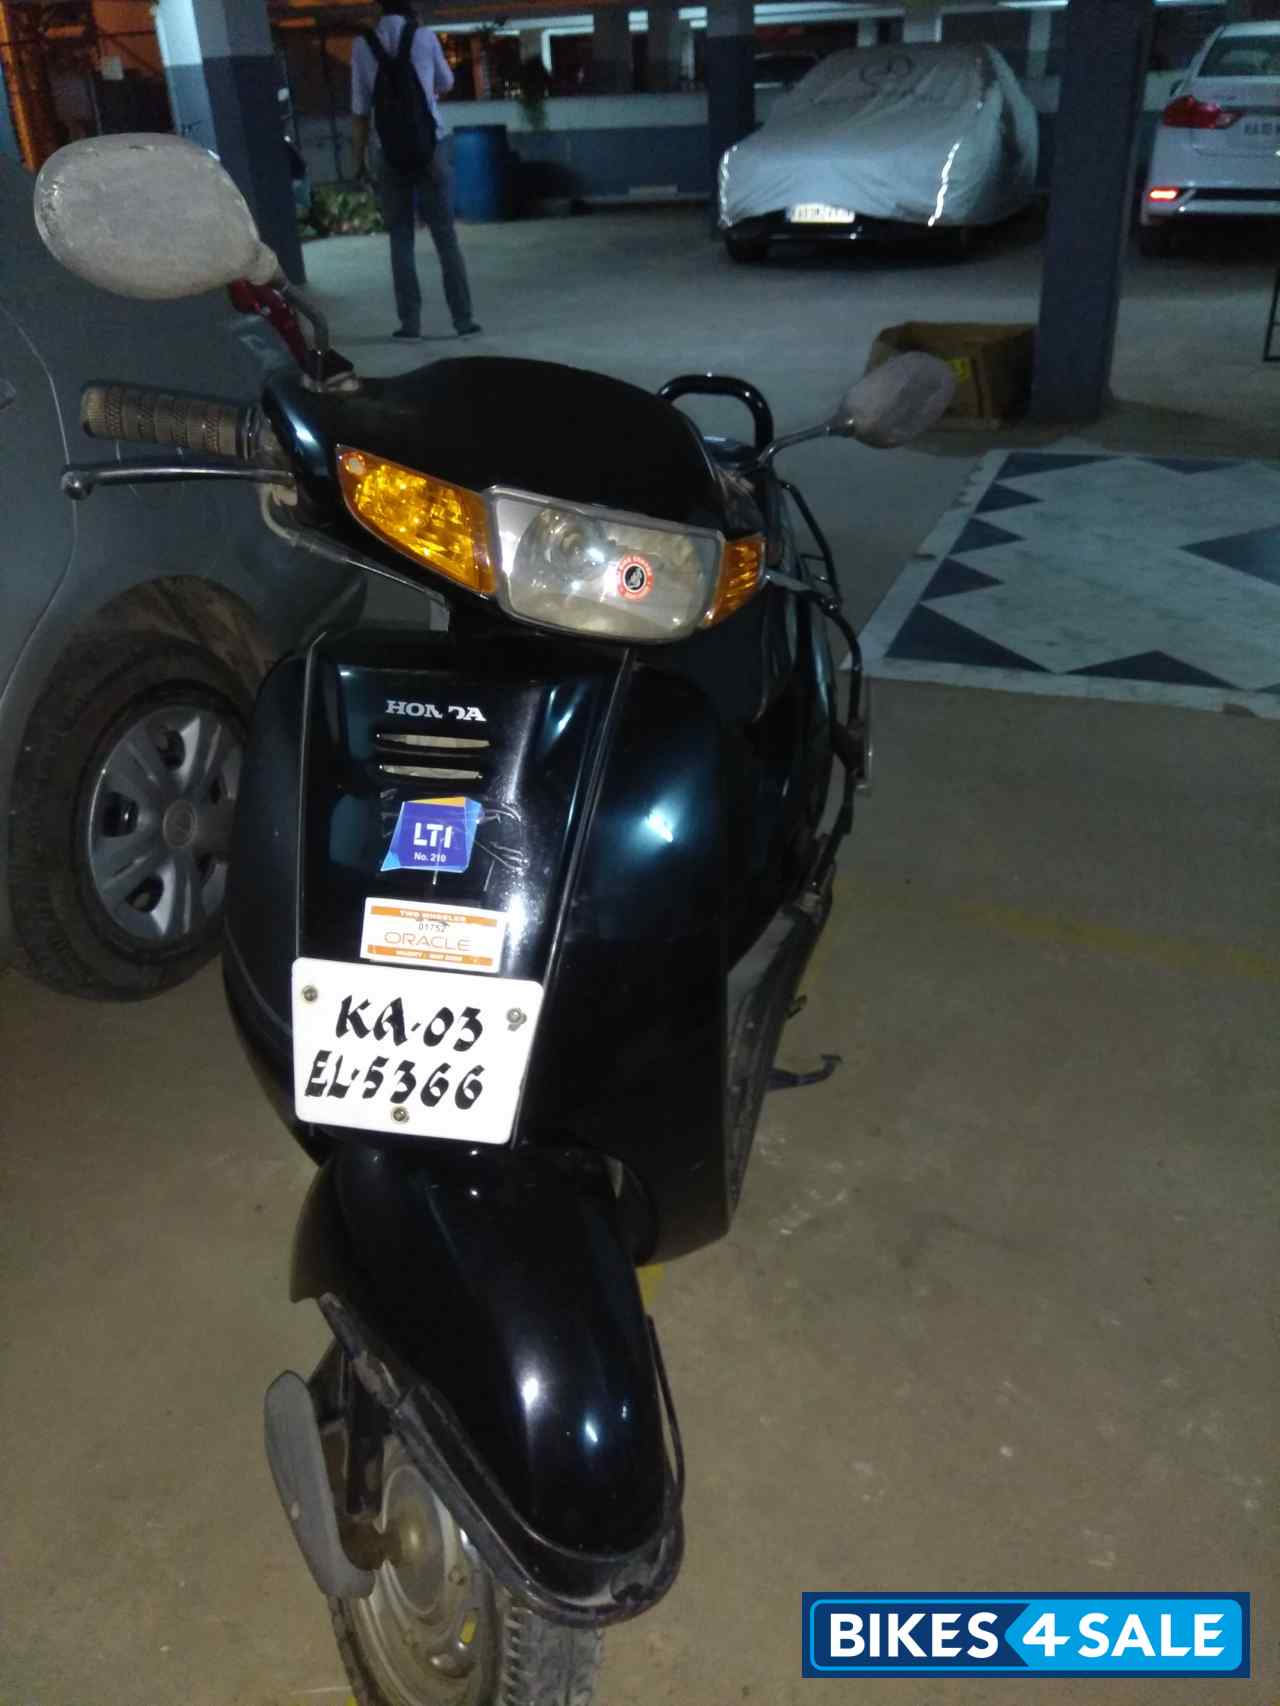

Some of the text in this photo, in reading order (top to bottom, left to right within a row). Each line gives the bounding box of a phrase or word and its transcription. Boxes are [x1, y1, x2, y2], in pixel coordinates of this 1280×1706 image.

[413, 822, 454, 849] LTI
[414, 852, 428, 862] No.
[399, 910, 421, 919] TWO
[384, 931, 472, 952] ORACLE
